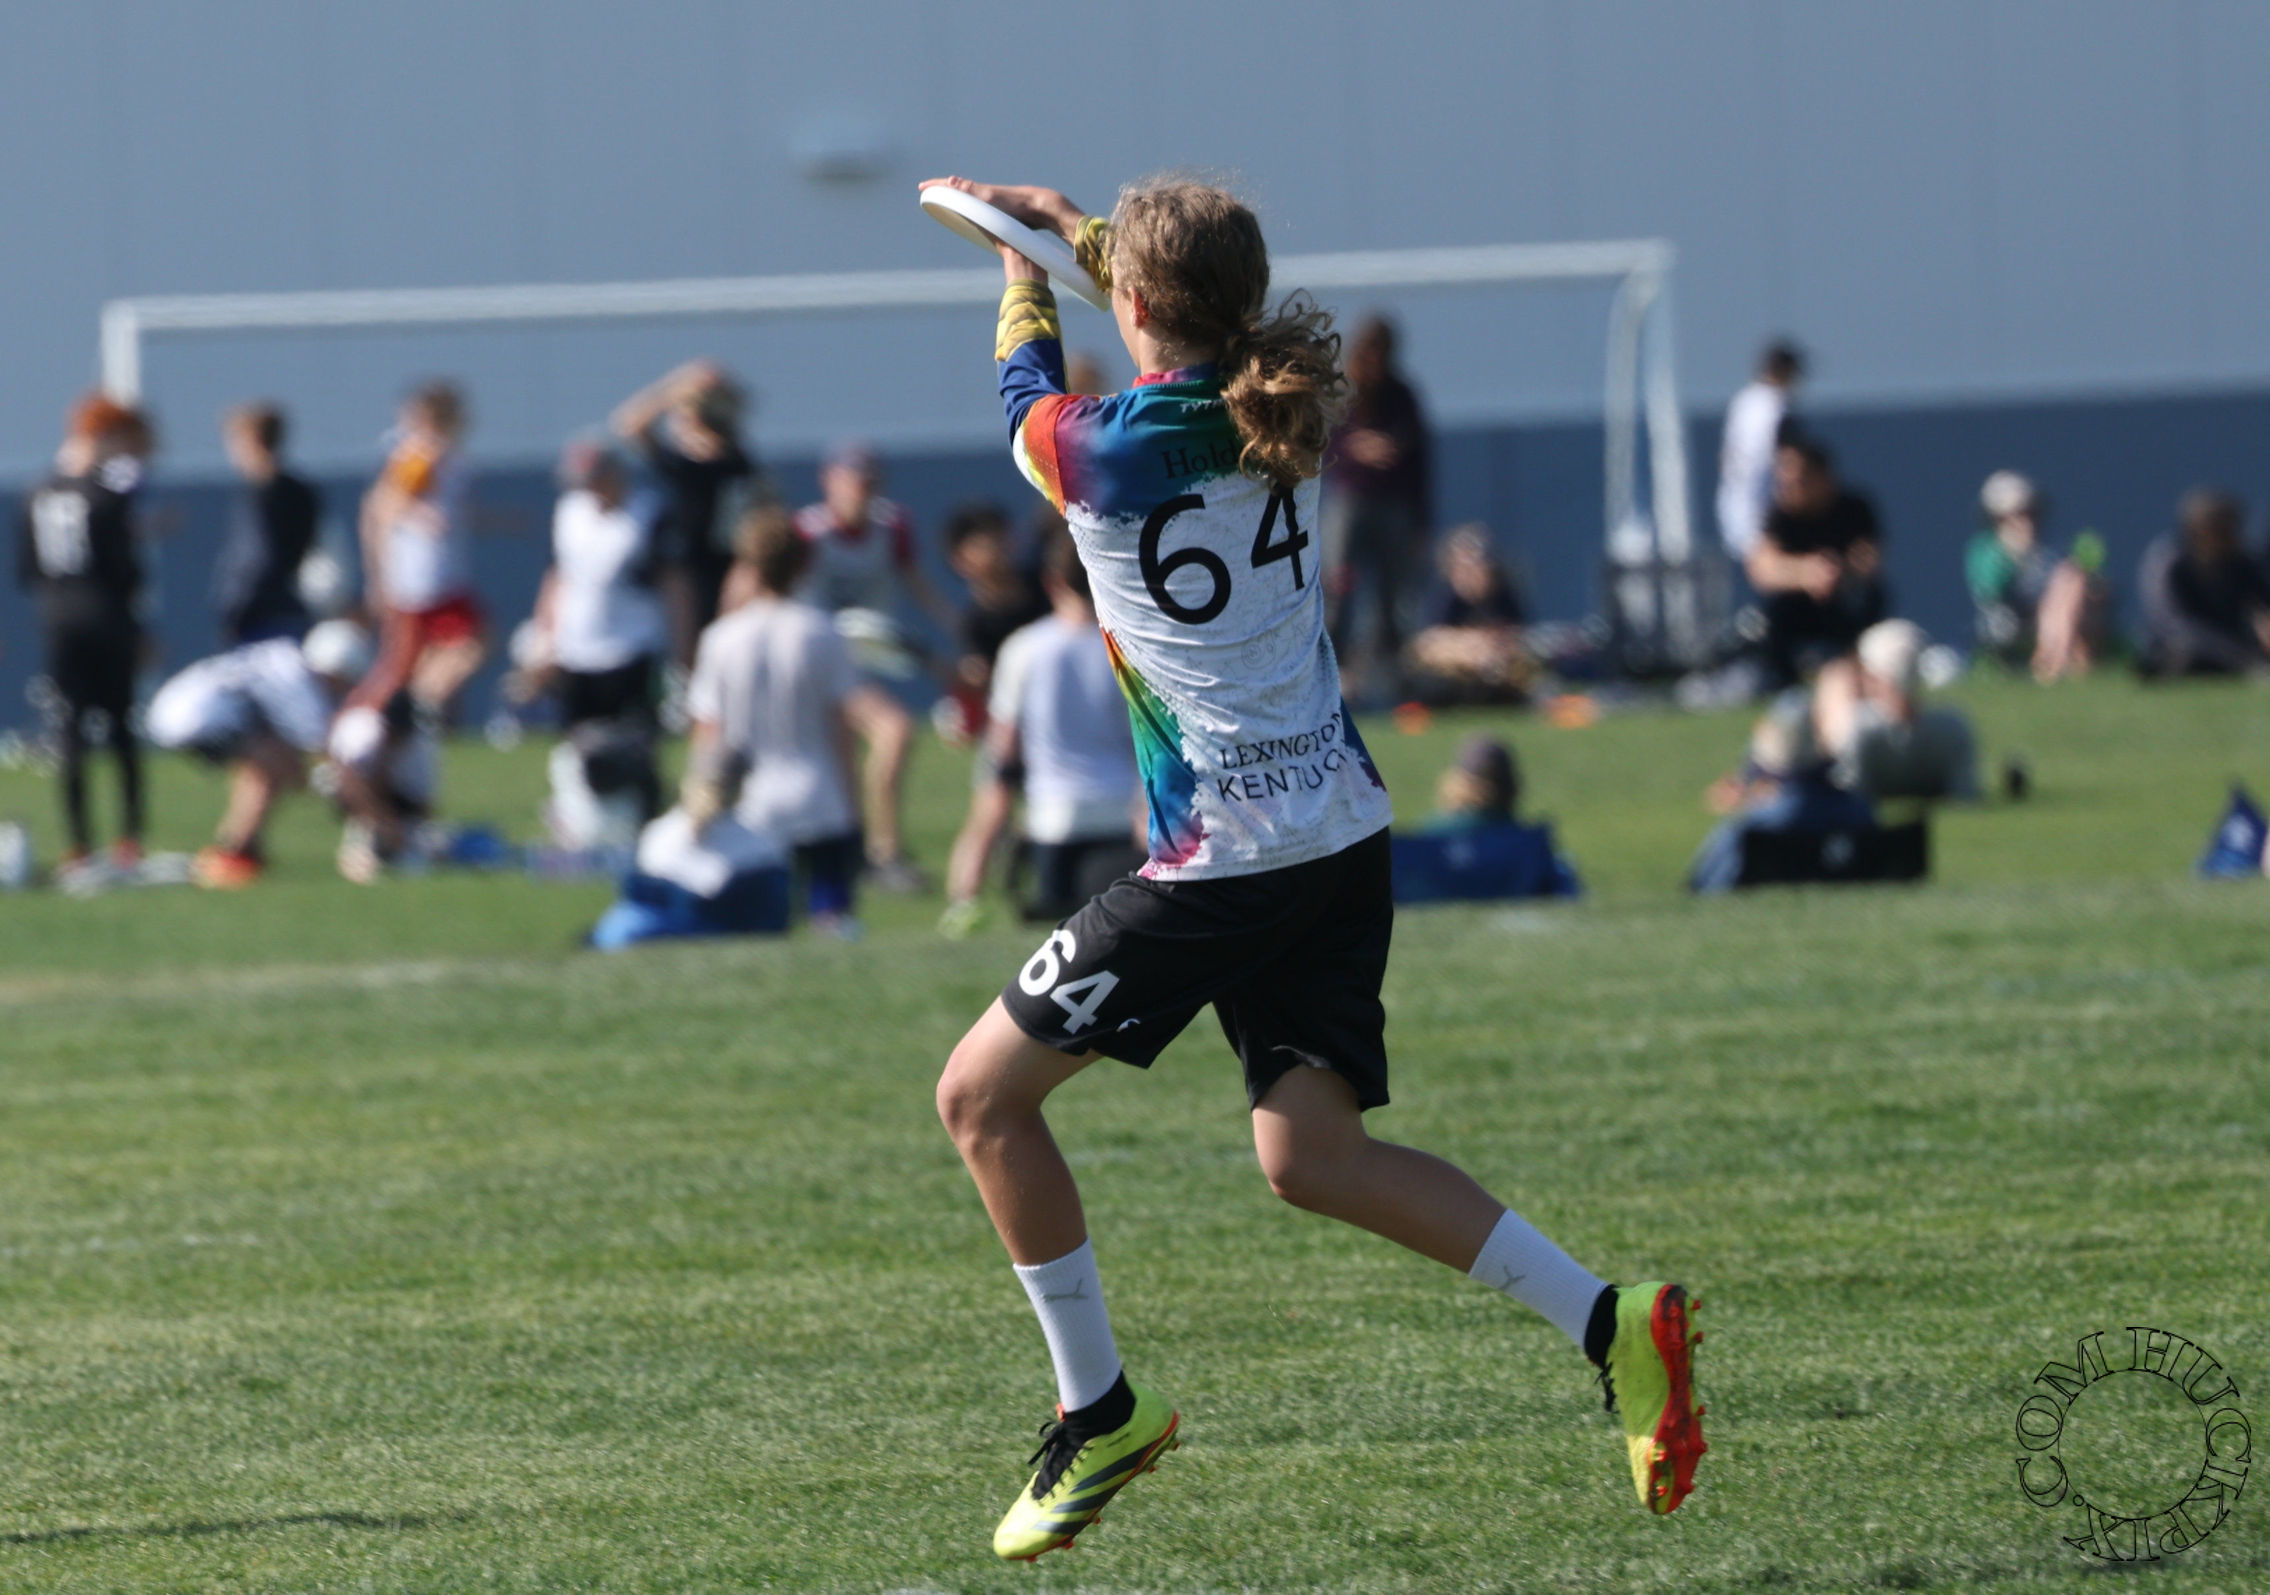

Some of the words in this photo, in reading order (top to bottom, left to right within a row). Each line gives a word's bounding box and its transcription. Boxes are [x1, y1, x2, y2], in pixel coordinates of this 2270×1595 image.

[1161, 439, 1239, 479] Hold
[1138, 487, 1309, 625] 64
[1217, 748, 1347, 802] KENTUC
[1018, 929, 1120, 1035] 64
